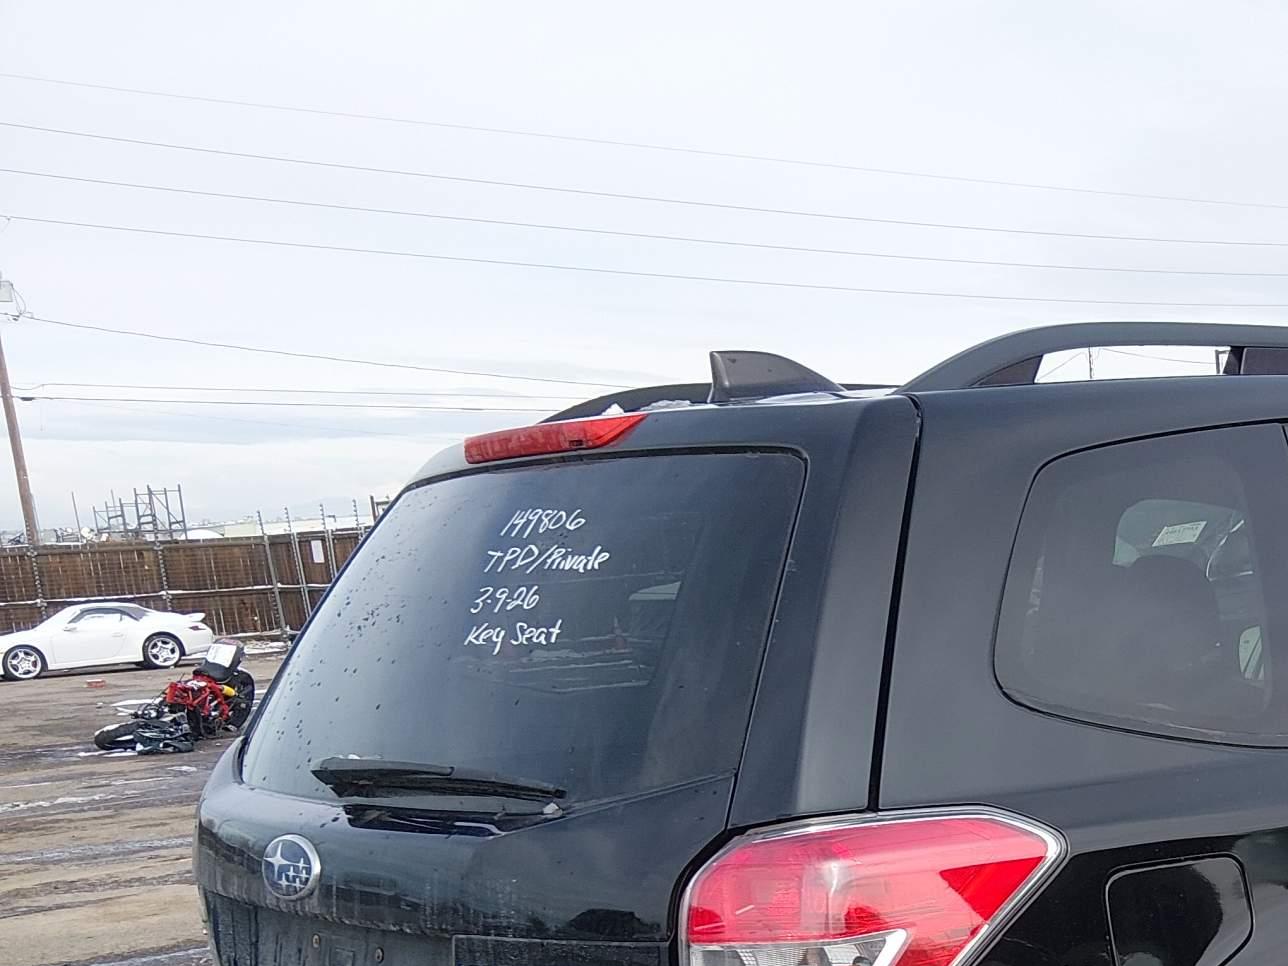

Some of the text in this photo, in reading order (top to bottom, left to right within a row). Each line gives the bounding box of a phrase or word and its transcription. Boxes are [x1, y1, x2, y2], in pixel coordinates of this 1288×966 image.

[500, 508, 586, 538] 149806
[464, 619, 562, 655] Key Seat
